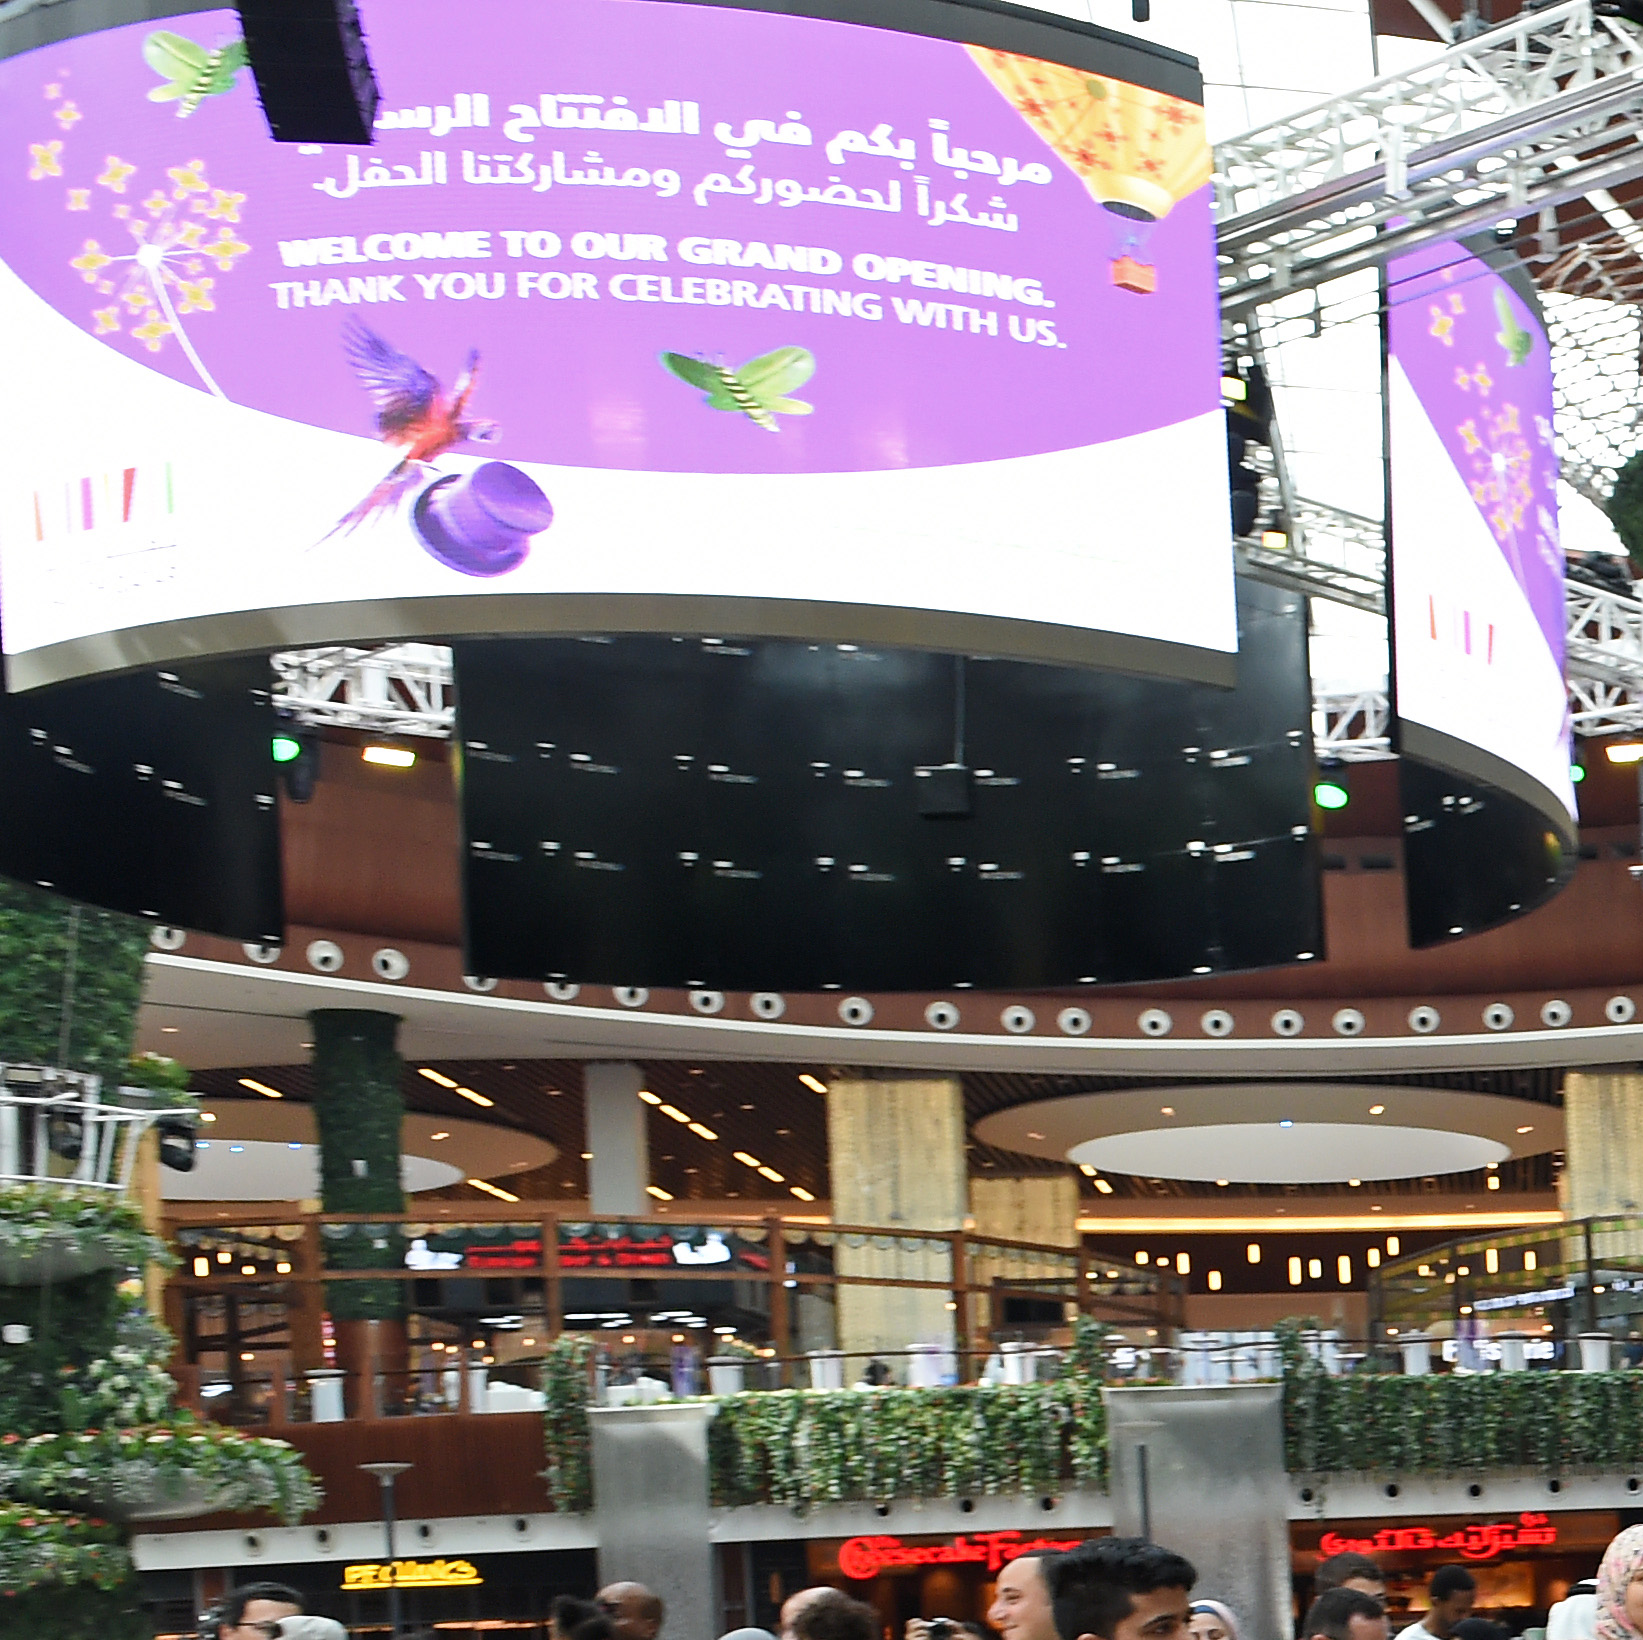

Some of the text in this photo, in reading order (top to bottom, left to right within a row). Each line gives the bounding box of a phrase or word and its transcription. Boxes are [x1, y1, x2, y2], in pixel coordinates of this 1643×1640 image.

[503, 92, 700, 143] الافتتاح
[713, 110, 813, 160] في
[825, 122, 917, 171] بكم
[928, 118, 1053, 186] مرحباً
[462, 150, 681, 198] ومشاركتنا
[693, 164, 902, 213] لحضوركم
[912, 174, 1019, 232] شكراً
[277, 230, 1056, 308] WELCOME TO OUR GRAND OPENING.
[267, 271, 1068, 349] THANK YOU FOR CELEBRATING WITH US.
